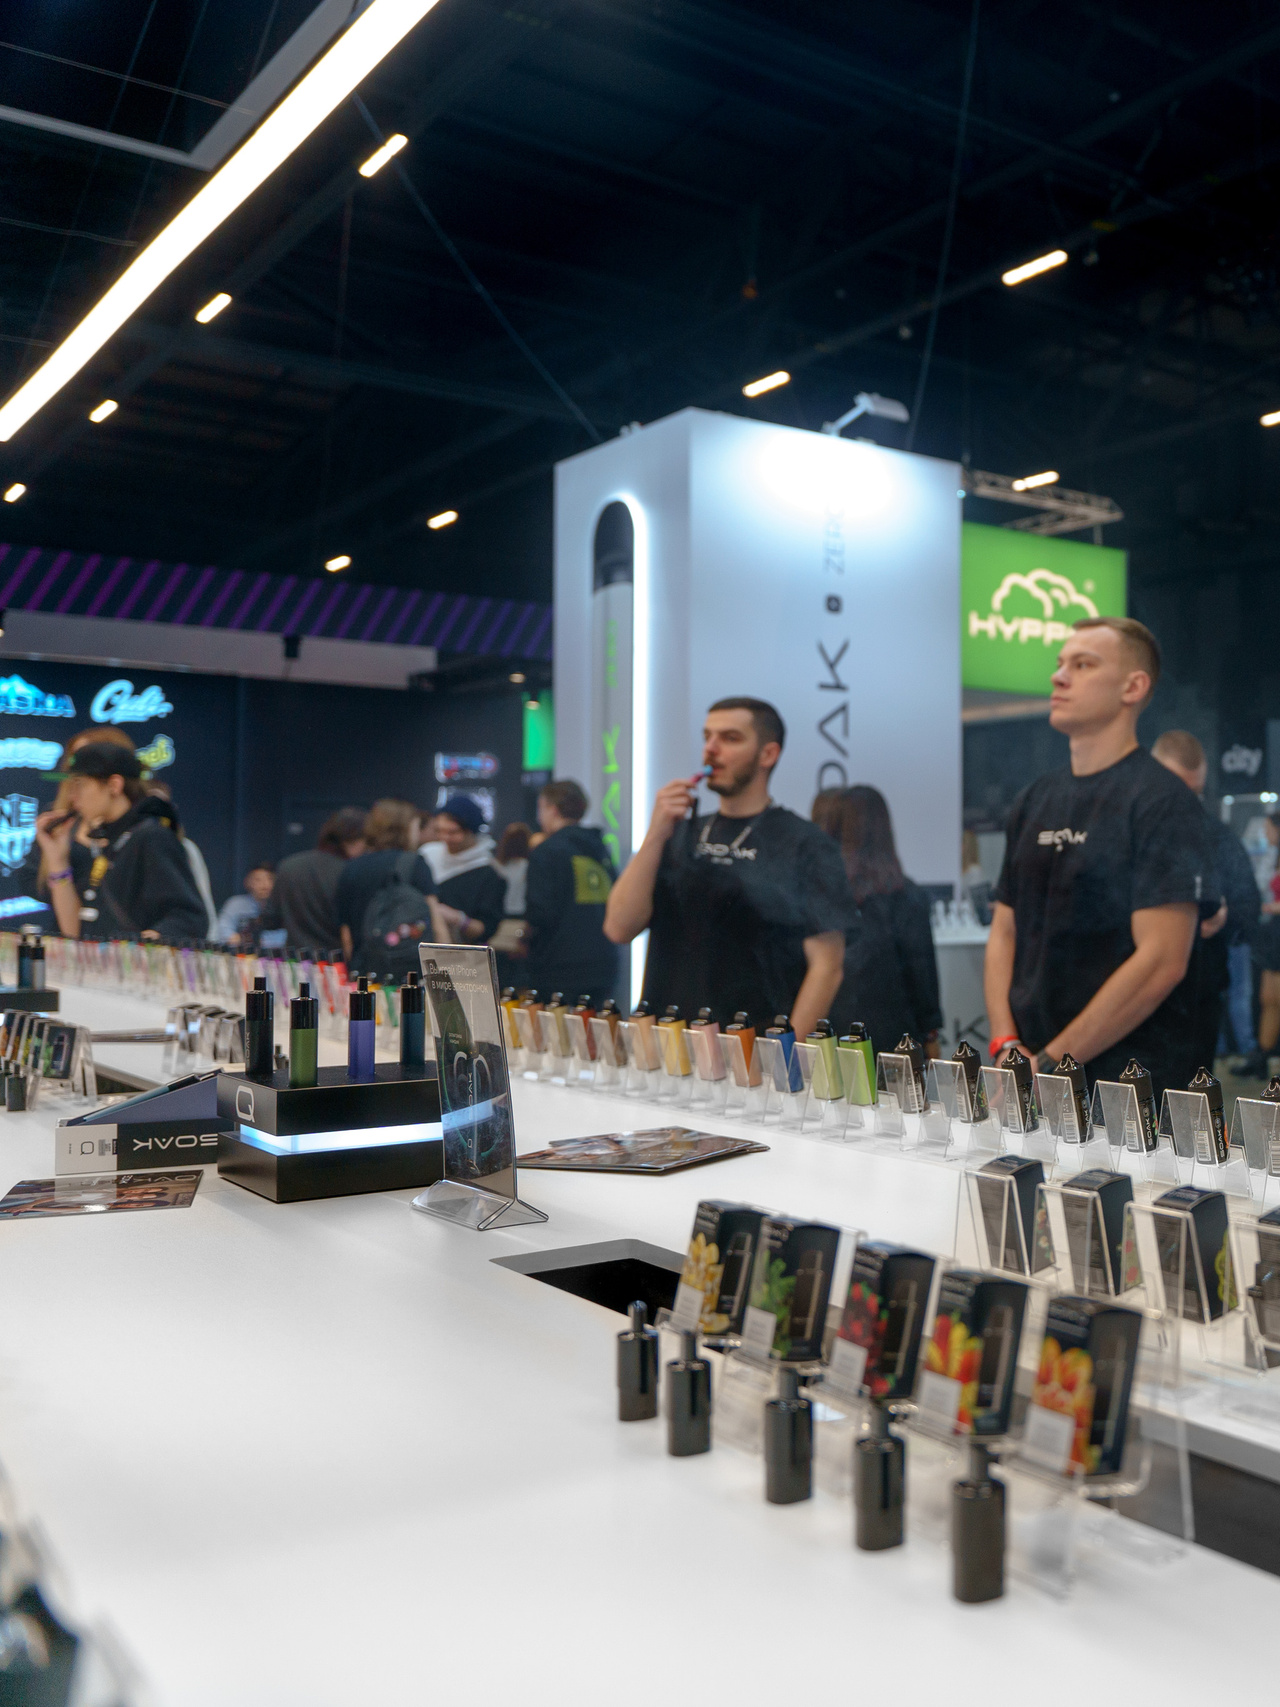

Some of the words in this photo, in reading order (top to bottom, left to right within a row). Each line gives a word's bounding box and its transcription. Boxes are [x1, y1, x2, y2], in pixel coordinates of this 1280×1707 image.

[455, 965, 478, 977] iPhone
[431, 980, 437, 990] в
[235, 1085, 256, 1124] Q
[133, 1133, 219, 1152] SOAK
